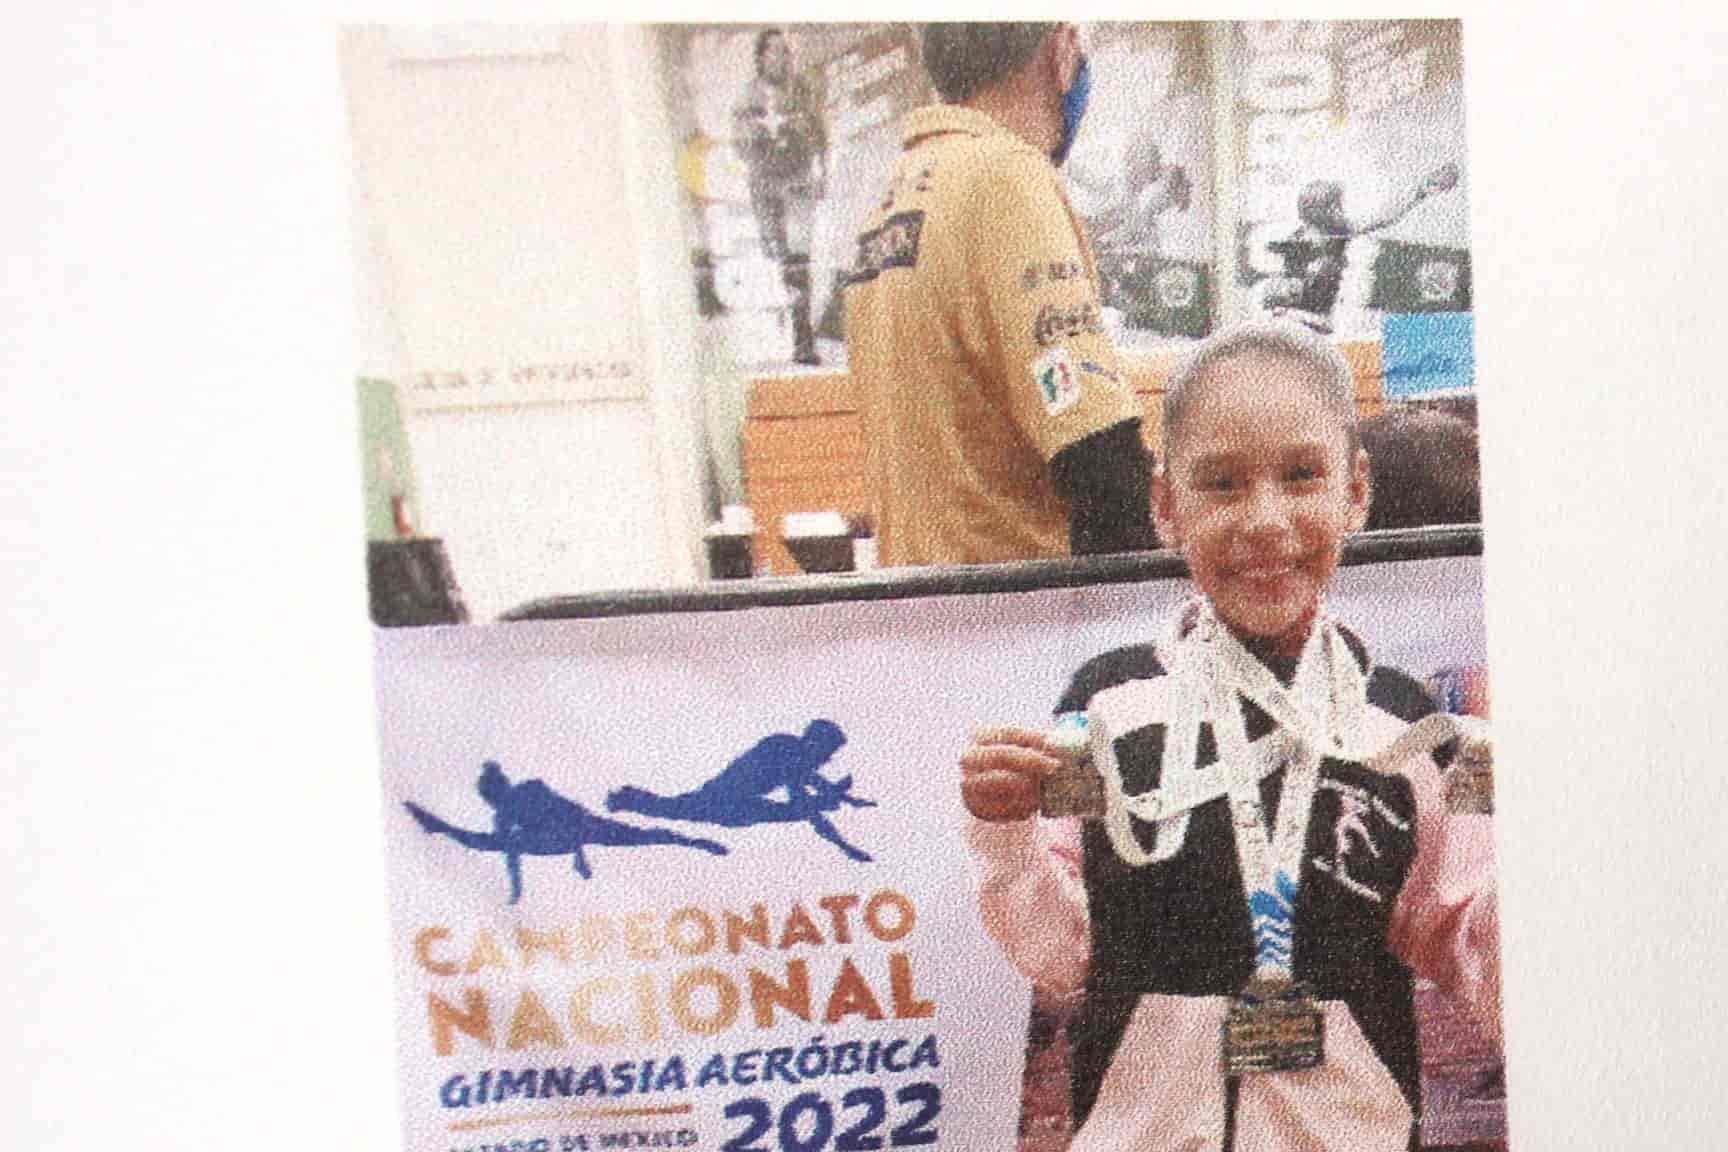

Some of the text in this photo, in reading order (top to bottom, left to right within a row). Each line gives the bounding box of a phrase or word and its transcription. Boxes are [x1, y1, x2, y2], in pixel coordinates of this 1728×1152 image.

[414, 888, 917, 977] CAMPEONATO
[429, 951, 937, 1057] NACIONAL
[440, 1033, 941, 1109] GIMNASIA AERÓBICA
[558, 1133, 592, 1152] DE
